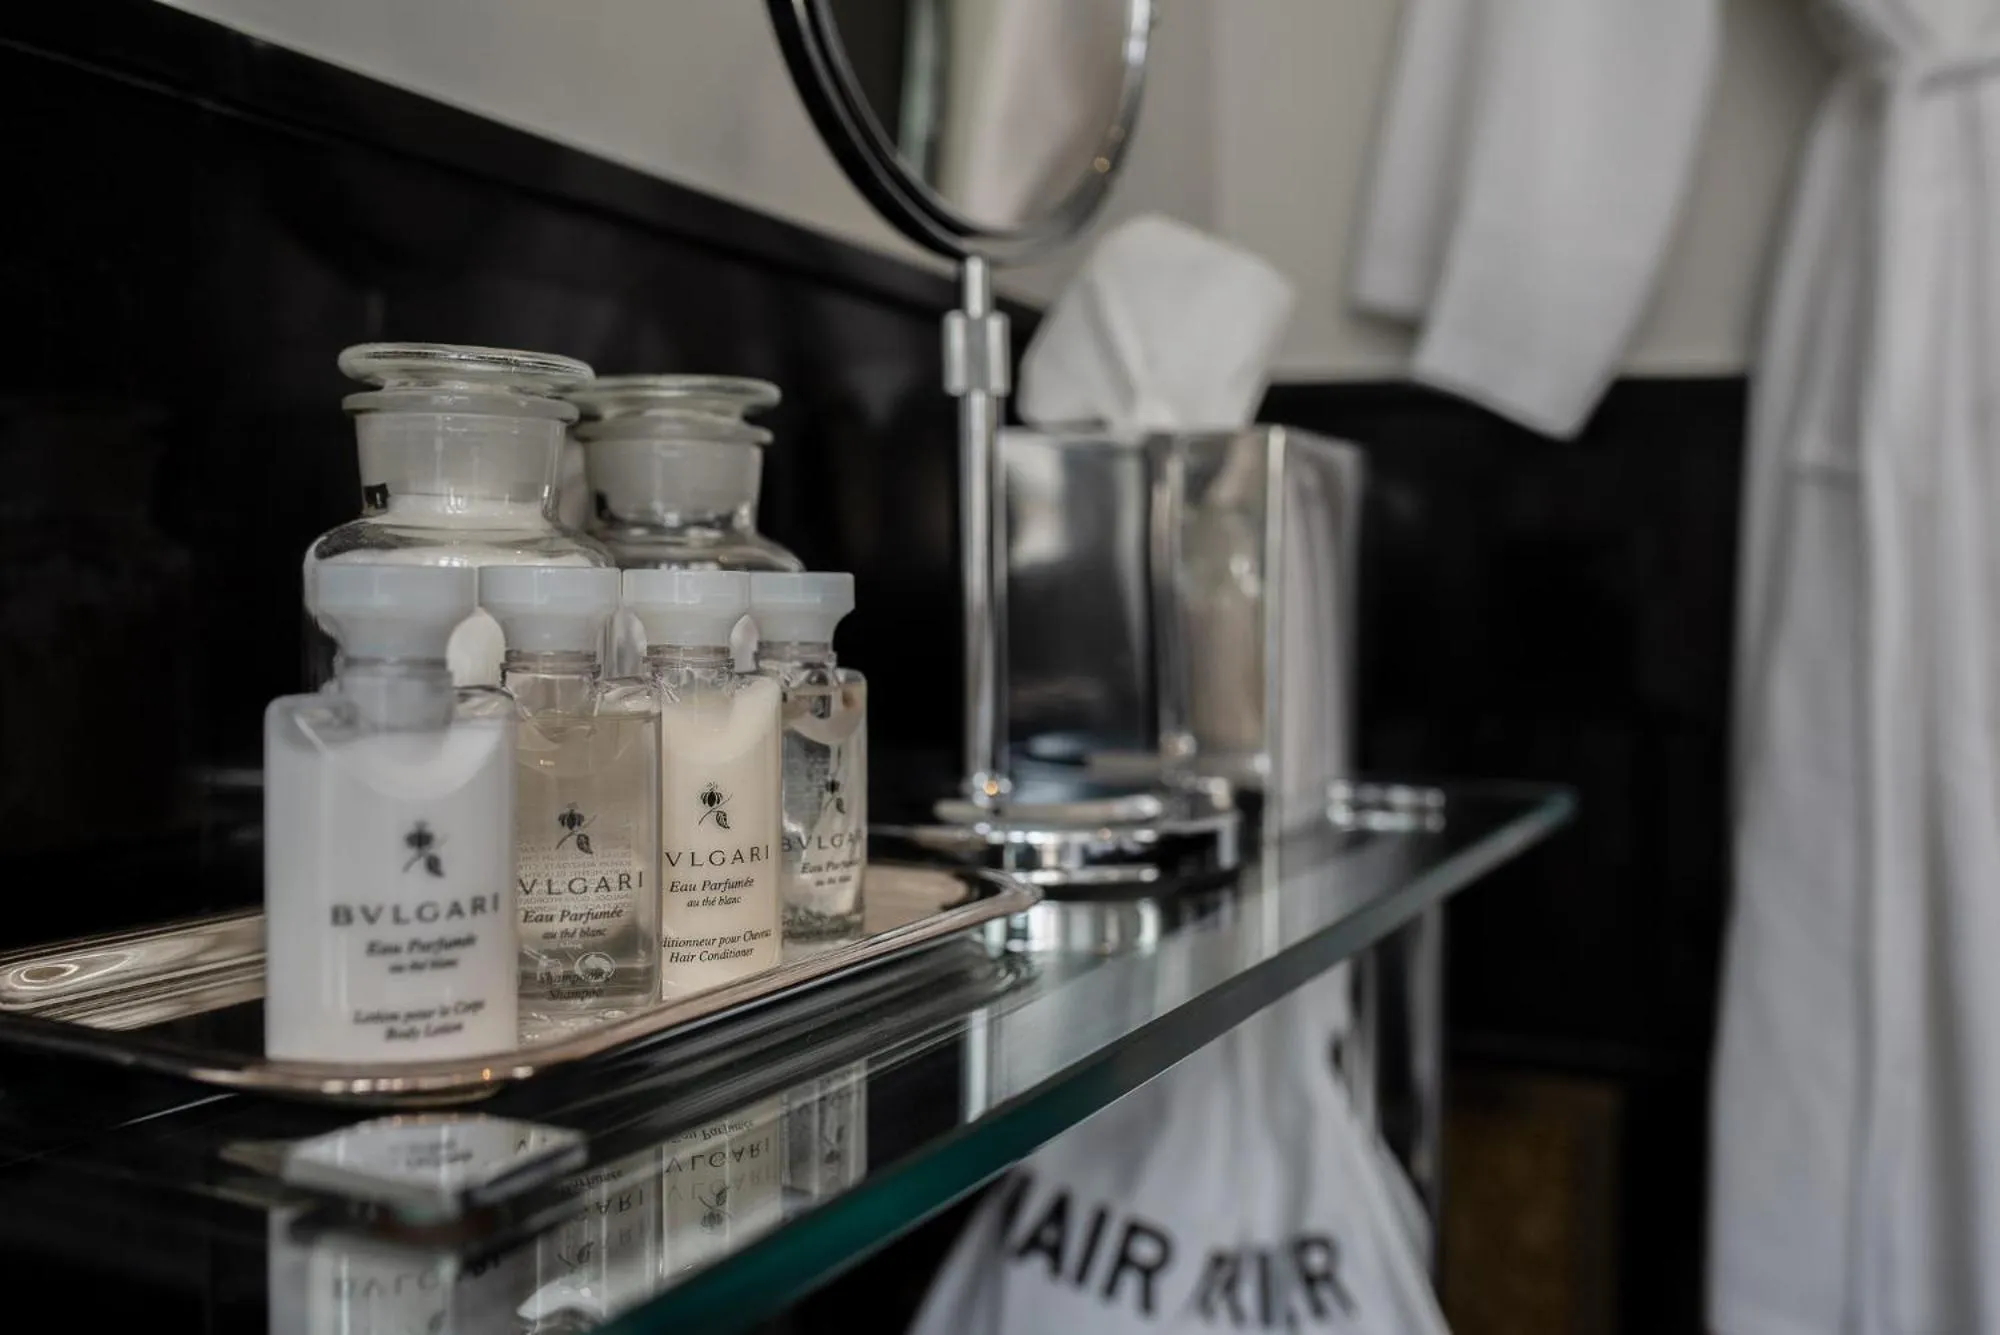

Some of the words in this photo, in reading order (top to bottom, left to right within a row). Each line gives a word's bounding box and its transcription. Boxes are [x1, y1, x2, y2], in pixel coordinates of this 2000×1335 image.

[670, 880, 696, 893] Eau
[701, 877, 755, 893] Parfumée
[330, 892, 499, 926] BVLGARI
[687, 899, 699, 907] au
[702, 896, 717, 906] thé
[718, 895, 741, 906] blanc
[522, 910, 554, 923] Eau
[559, 906, 623, 925] Parfumée
[718, 935, 741, 949] pour
[669, 951, 696, 963] Hair
[699, 947, 754, 962] Conditioner
